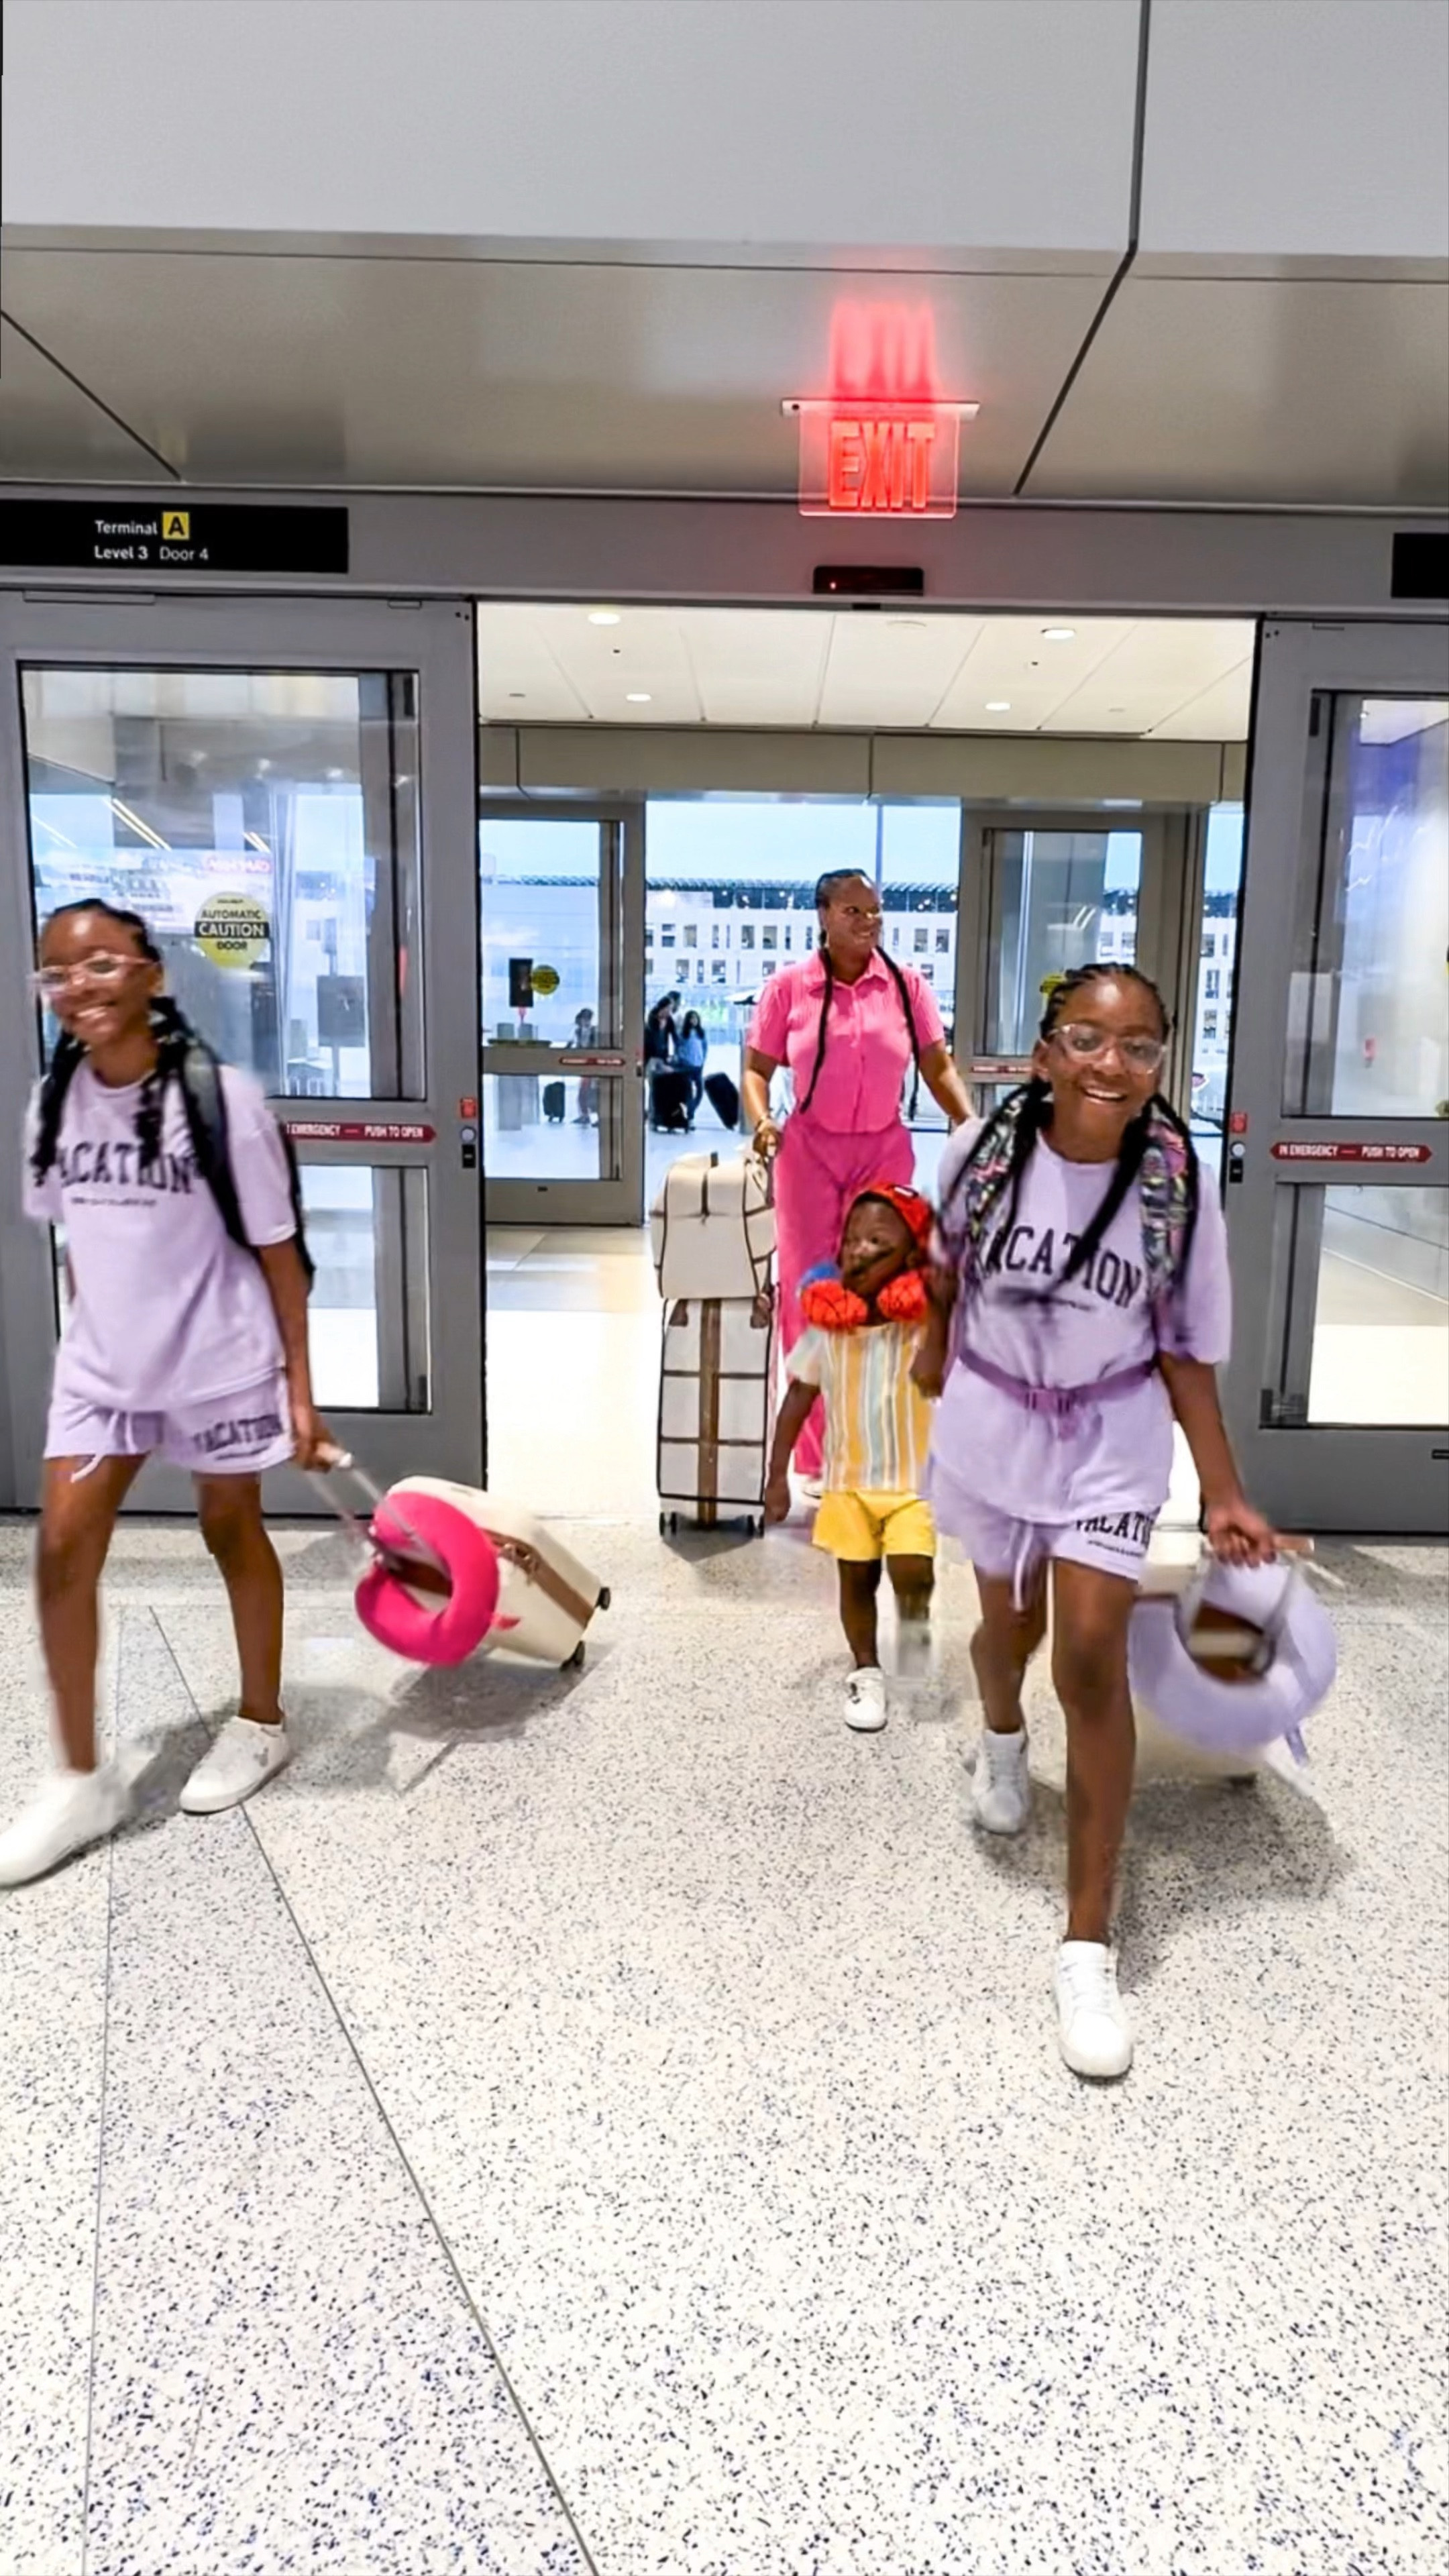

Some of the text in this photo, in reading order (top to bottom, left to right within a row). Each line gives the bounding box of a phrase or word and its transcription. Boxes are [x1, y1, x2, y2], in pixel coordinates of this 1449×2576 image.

[828, 421, 935, 510] EXIT
[95, 515, 185, 536] Terminal A
[94, 545, 209, 560] Level 3 Door 4
[201, 909, 262, 920] AUTOMATIC
[199, 922, 265, 937] CAUTION
[216, 941, 248, 951] DOOR
[291, 1124, 341, 1136] EMERGENCY
[364, 1124, 387, 1138] PUSH
[388, 1125, 400, 1138] TO
[400, 1126, 424, 1138] OPEN
[1279, 1144, 1420, 1159] IN EMERGENCY PUSH TO OPEN
